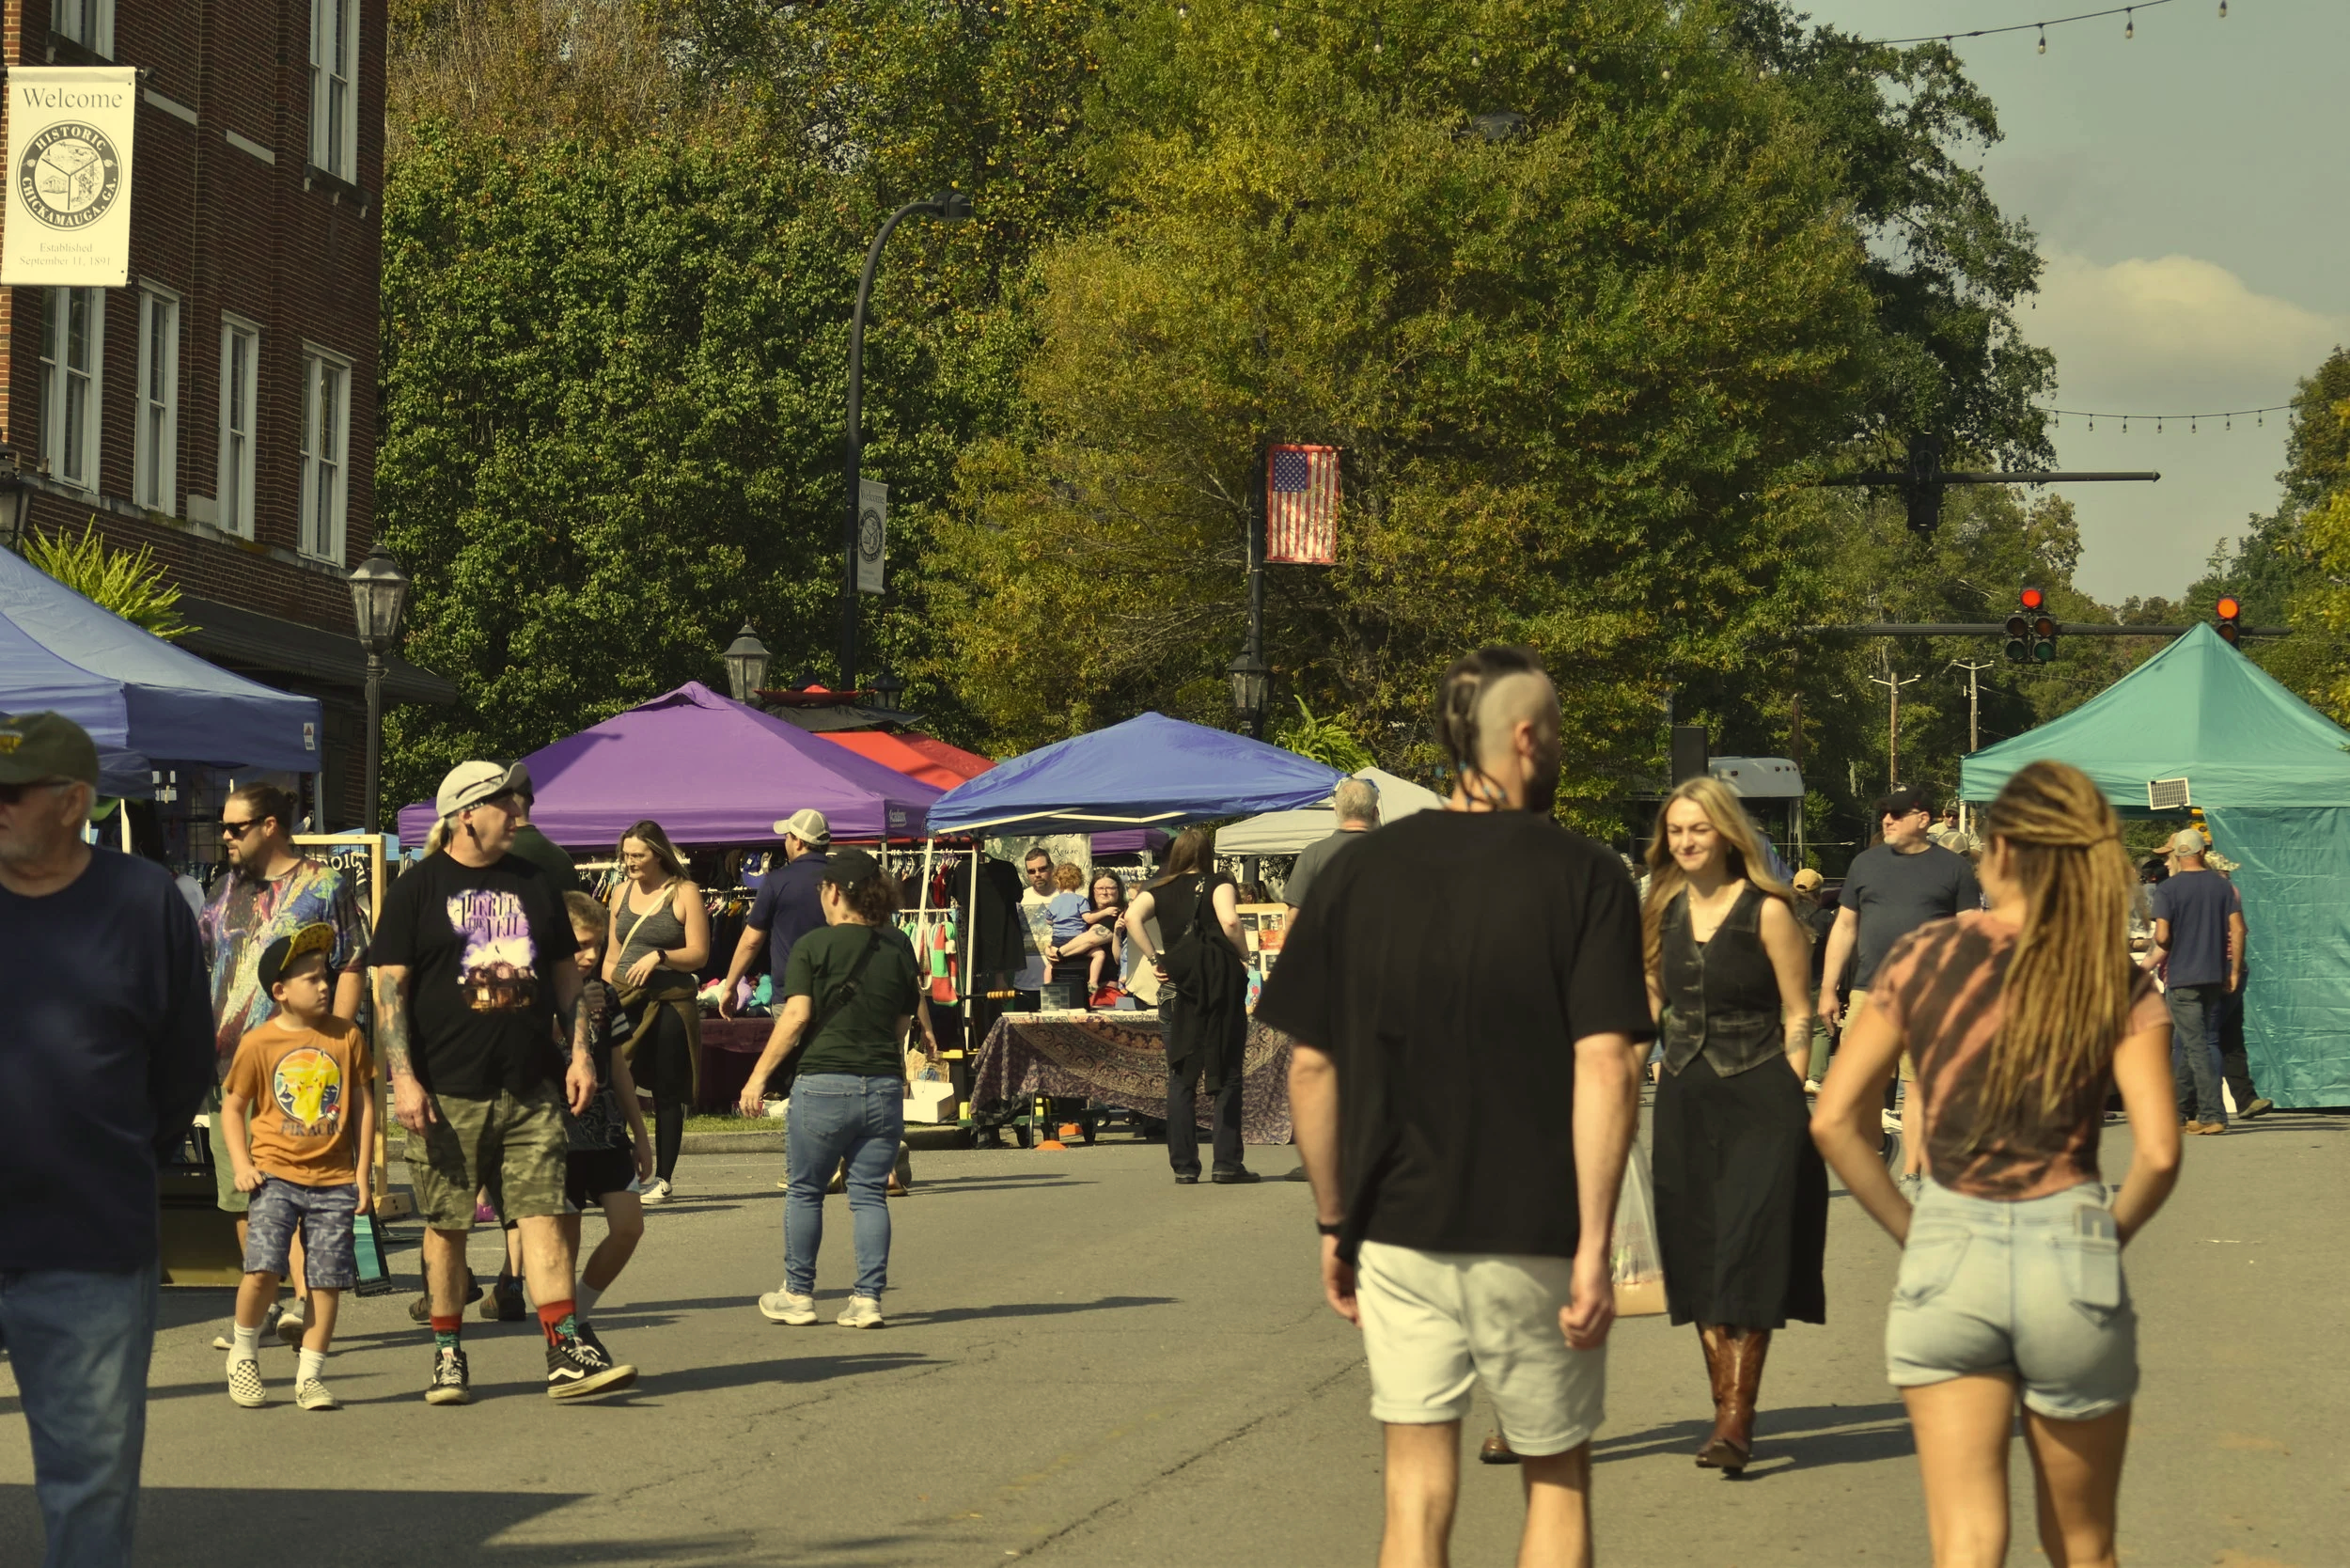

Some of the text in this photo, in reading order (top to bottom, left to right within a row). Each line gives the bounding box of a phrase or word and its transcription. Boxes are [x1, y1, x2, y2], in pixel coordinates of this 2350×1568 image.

[23, 87, 122, 108] Welcome
[35, 126, 106, 150] HISTORIC
[22, 177, 118, 227] CHICKAMAUGA, GA.
[39, 243, 93, 252] Established
[20, 256, 110, 267] September 11, 1891
[860, 489, 885, 504] Welcome
